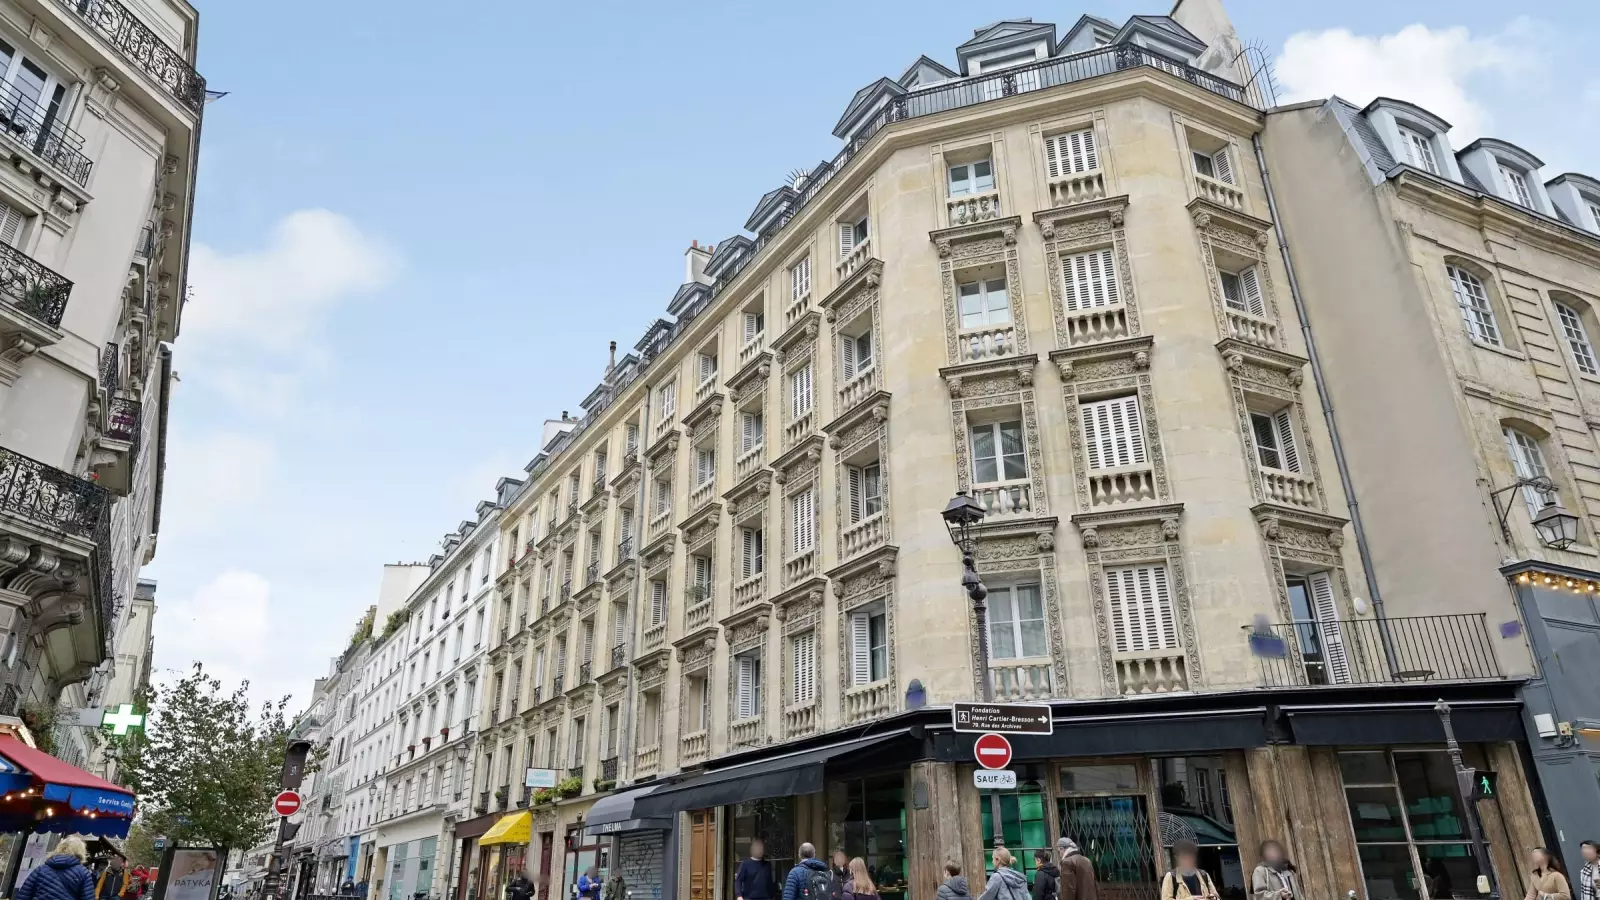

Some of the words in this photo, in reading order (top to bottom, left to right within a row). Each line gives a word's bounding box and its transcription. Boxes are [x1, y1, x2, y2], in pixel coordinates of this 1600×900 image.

[971, 706, 1000, 714] Fondation
[988, 715, 1034, 723] Cartier-Bresson
[976, 775, 999, 783] SAUF
[98, 796, 120, 806] Service
[602, 821, 622, 833] THELMA
[174, 879, 211, 887] PATYKA
